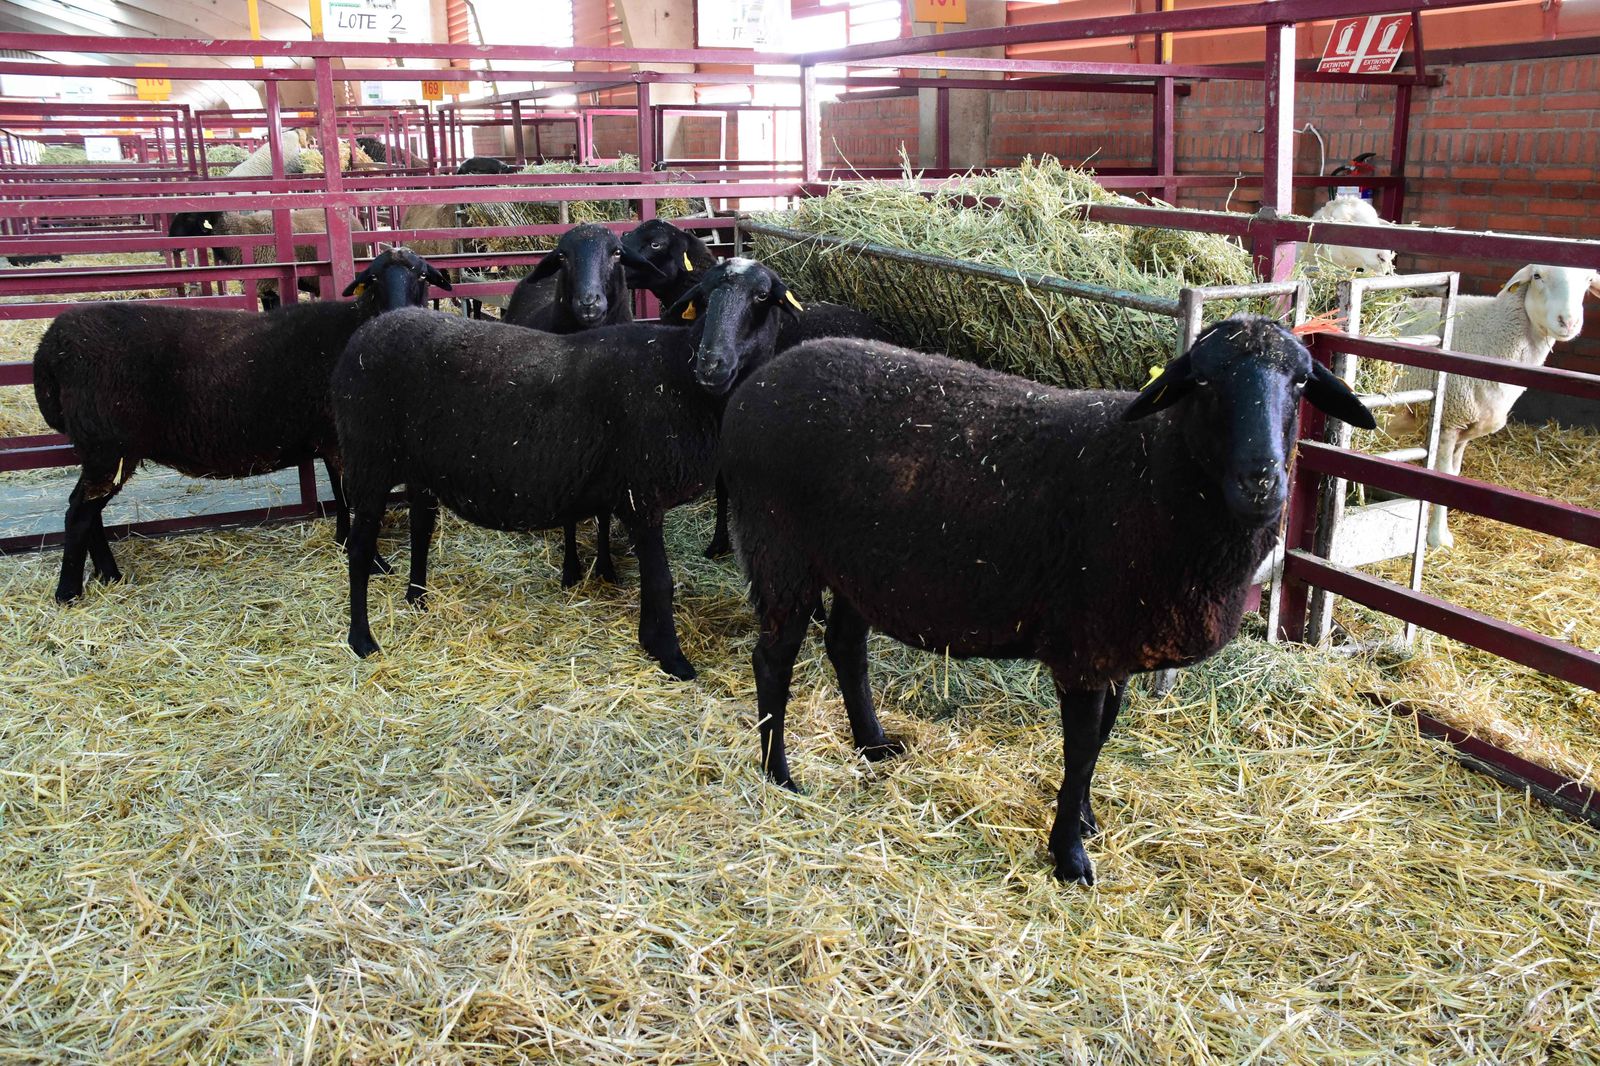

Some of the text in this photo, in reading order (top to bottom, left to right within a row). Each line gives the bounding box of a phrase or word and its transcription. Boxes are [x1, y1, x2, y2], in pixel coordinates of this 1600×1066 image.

[338, 11, 407, 30] LOTE 2
[423, 81, 439, 95] 169
